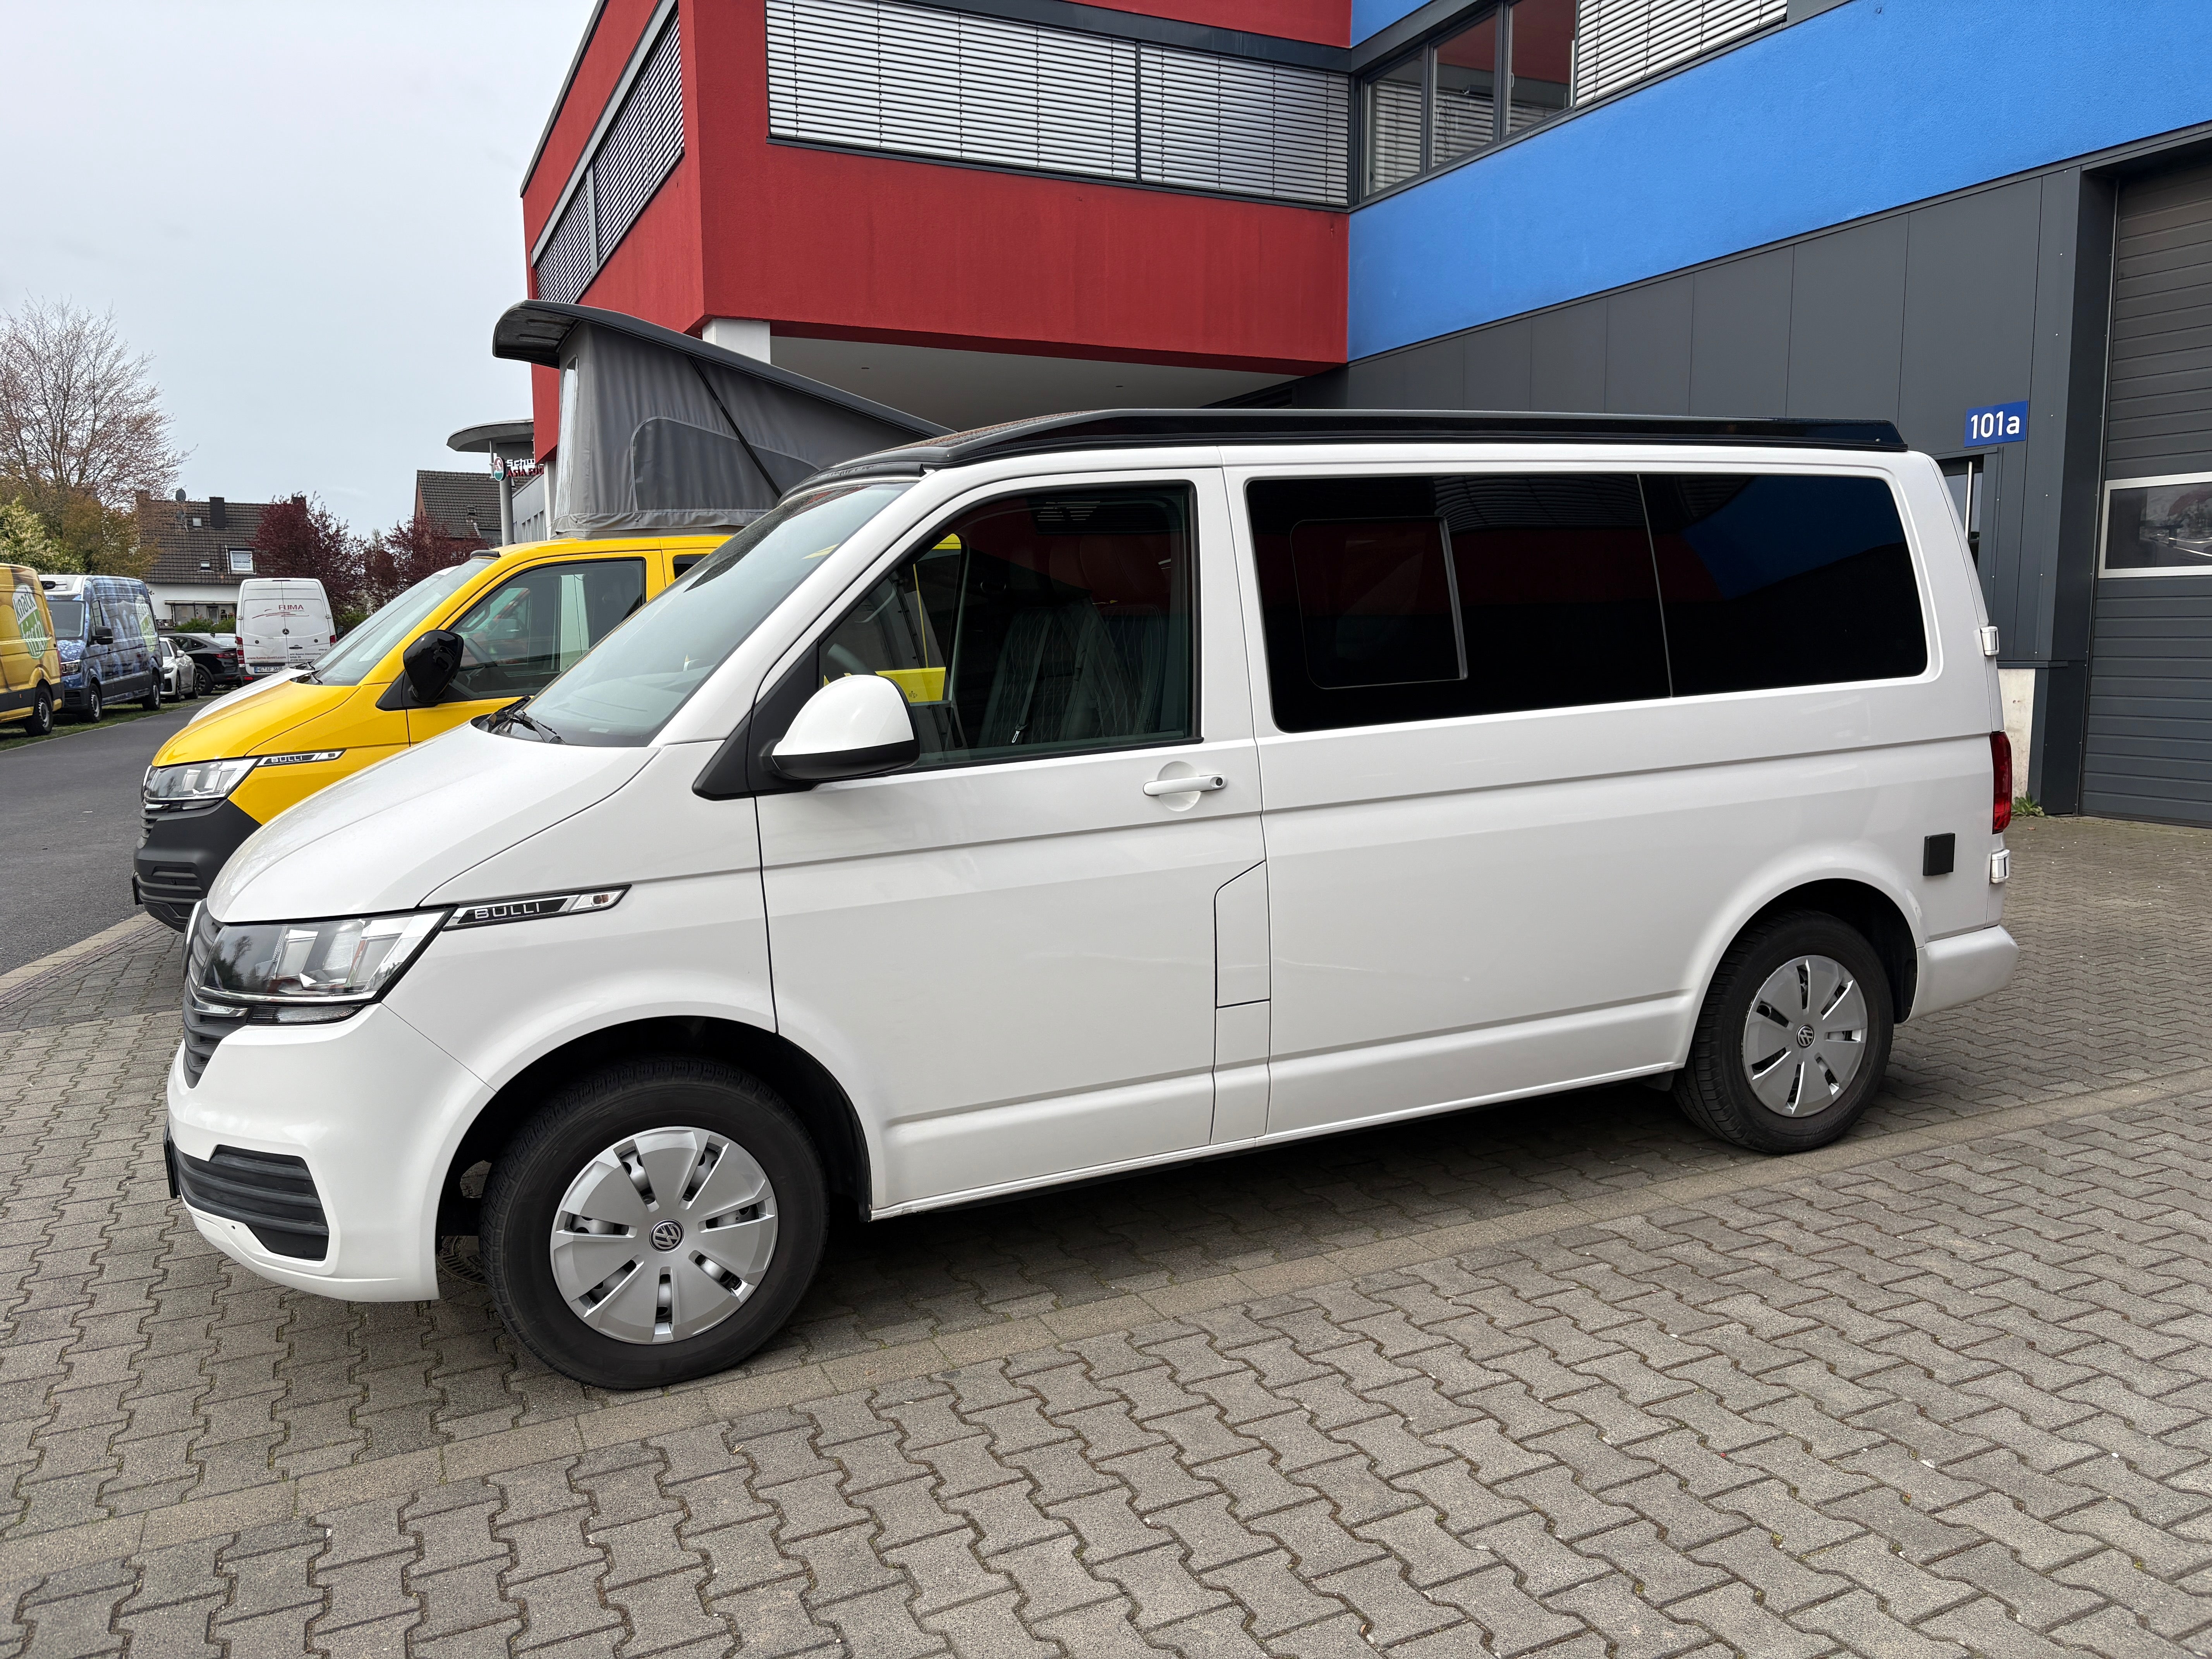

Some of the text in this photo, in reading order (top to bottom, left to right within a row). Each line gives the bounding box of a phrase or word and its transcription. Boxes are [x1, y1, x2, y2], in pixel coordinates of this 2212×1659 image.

[1971, 411, 2020, 439] 101a
[507, 459, 535, 467] Schw
[528, 466, 544, 475] FOO
[13, 587, 36, 621] knack
[474, 903, 539, 919] BULLI
[651, 1221, 683, 1251] VW
